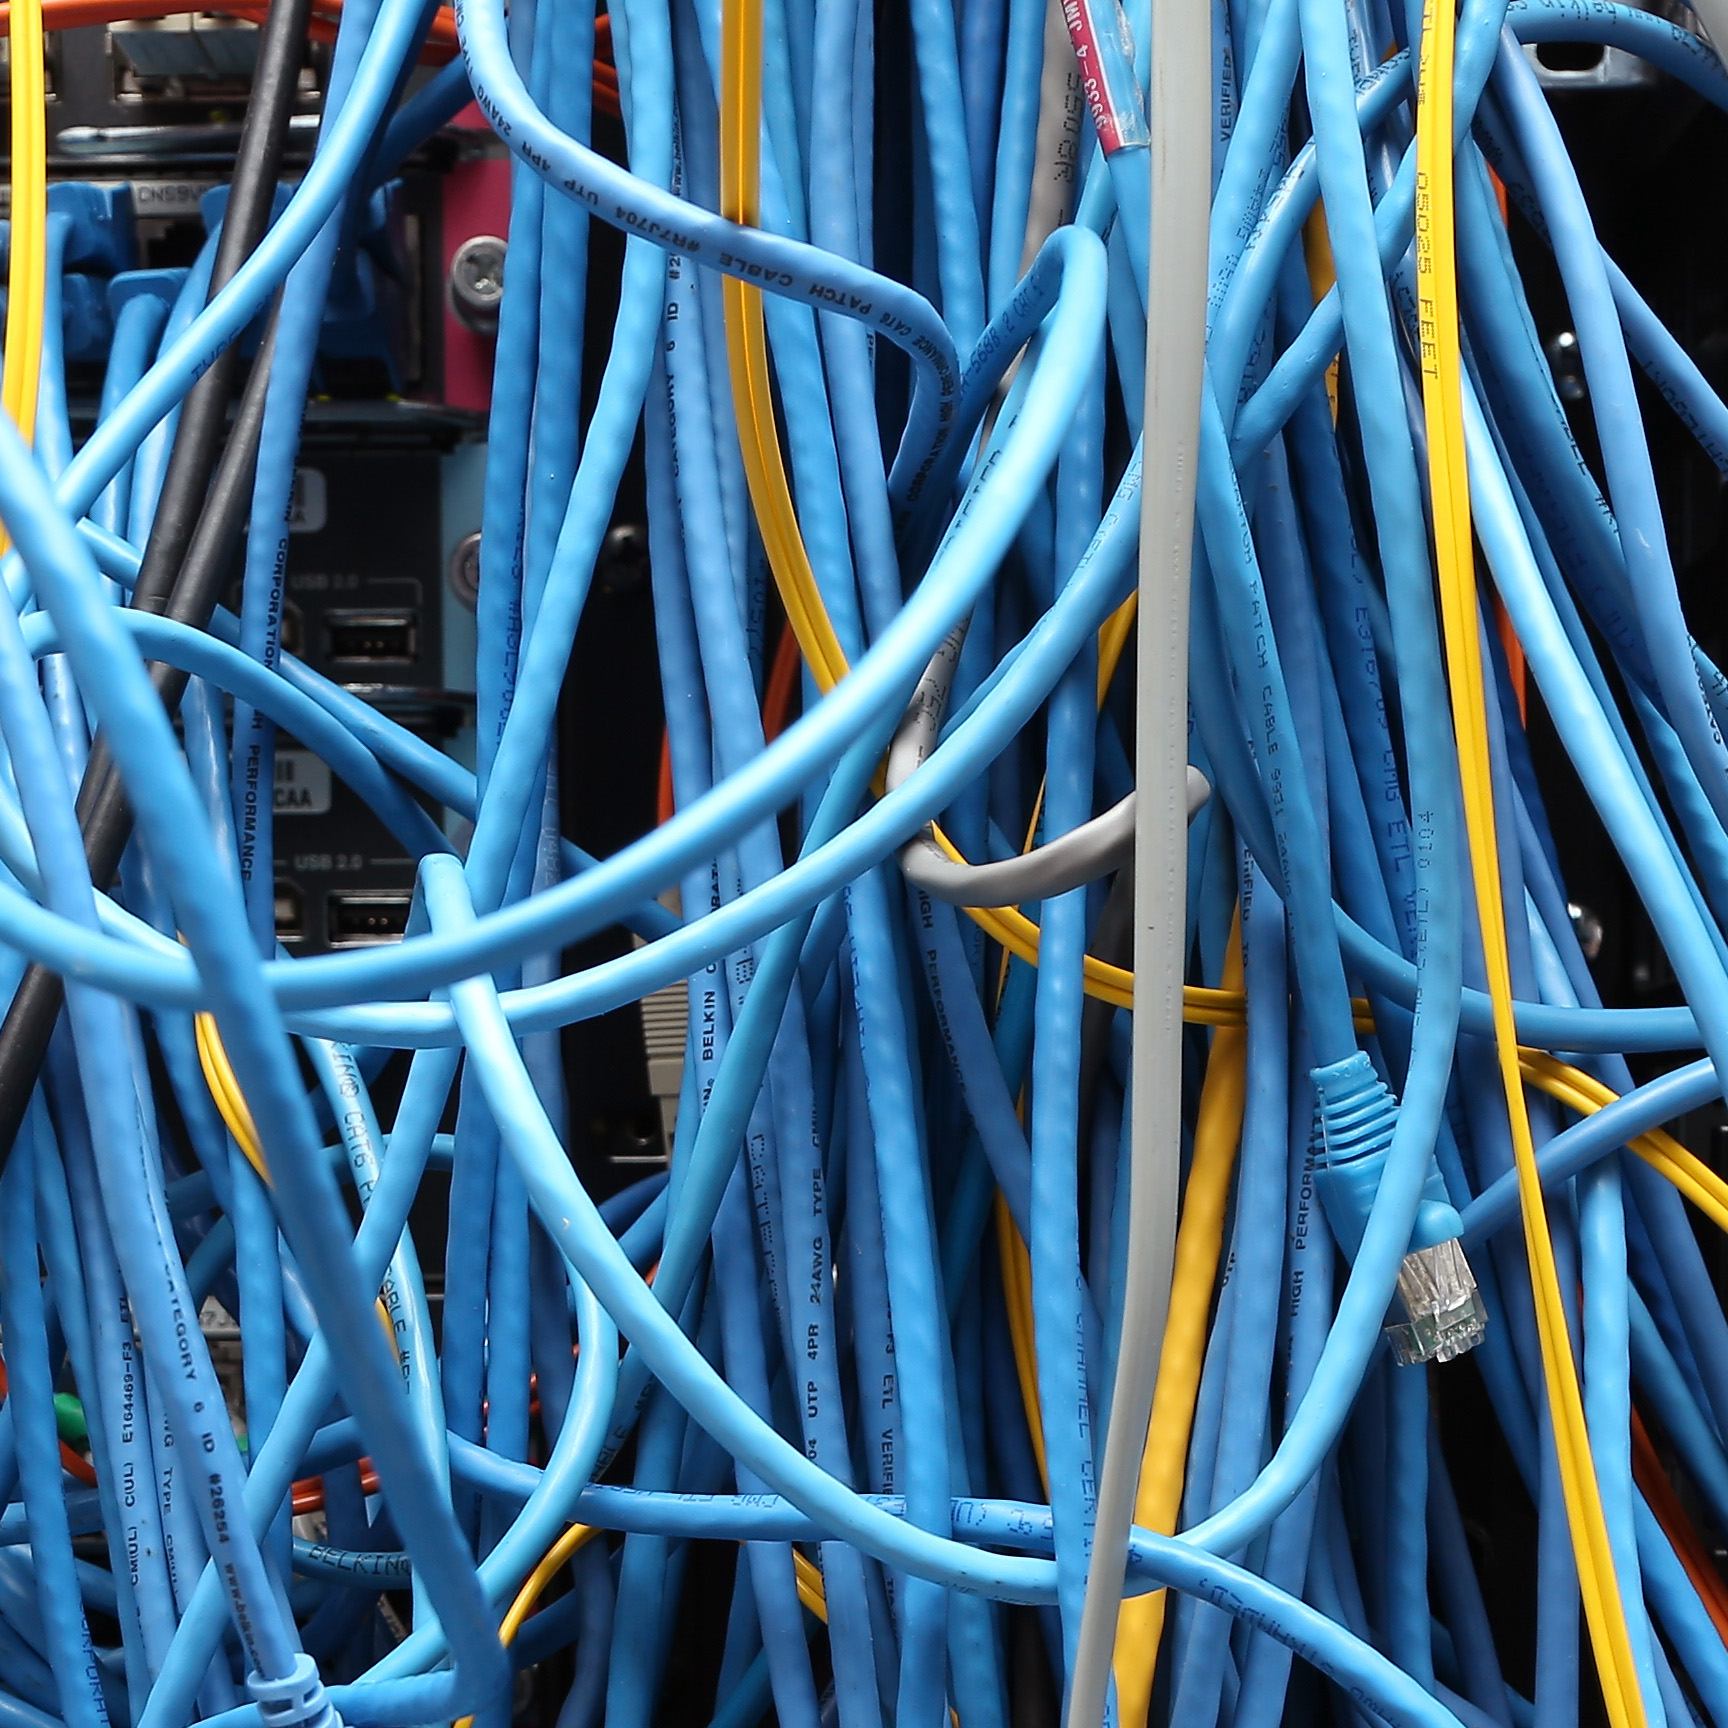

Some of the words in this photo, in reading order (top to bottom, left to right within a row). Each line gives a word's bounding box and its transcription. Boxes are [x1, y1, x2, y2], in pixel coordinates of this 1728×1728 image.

[477, 84, 513, 139] 24AWG
[521, 137, 552, 172] 4PR
[561, 176, 600, 205] UTP
[613, 204, 701, 252] #R7J704
[719, 251, 793, 286] CABLE
[807, 280, 872, 318] PATCH
[1418, 300, 1439, 380] FEET
[263, 538, 289, 670] CORPORATION
[240, 744, 263, 882] PERFORMANCE
[703, 990, 716, 1063] BELKIN
[810, 1168, 826, 1217] TYPE
[807, 1232, 825, 1305] 24AWG
[807, 1322, 819, 1362] 4PR
[120, 1341, 136, 1445] E164469-F3
[807, 1380, 819, 1418] UTP
[201, 1431, 216, 1453] ID
[123, 1463, 136, 1506] C(UL)
[160, 1466, 175, 1515] TYPE
[206, 1471, 231, 1543] #26254
